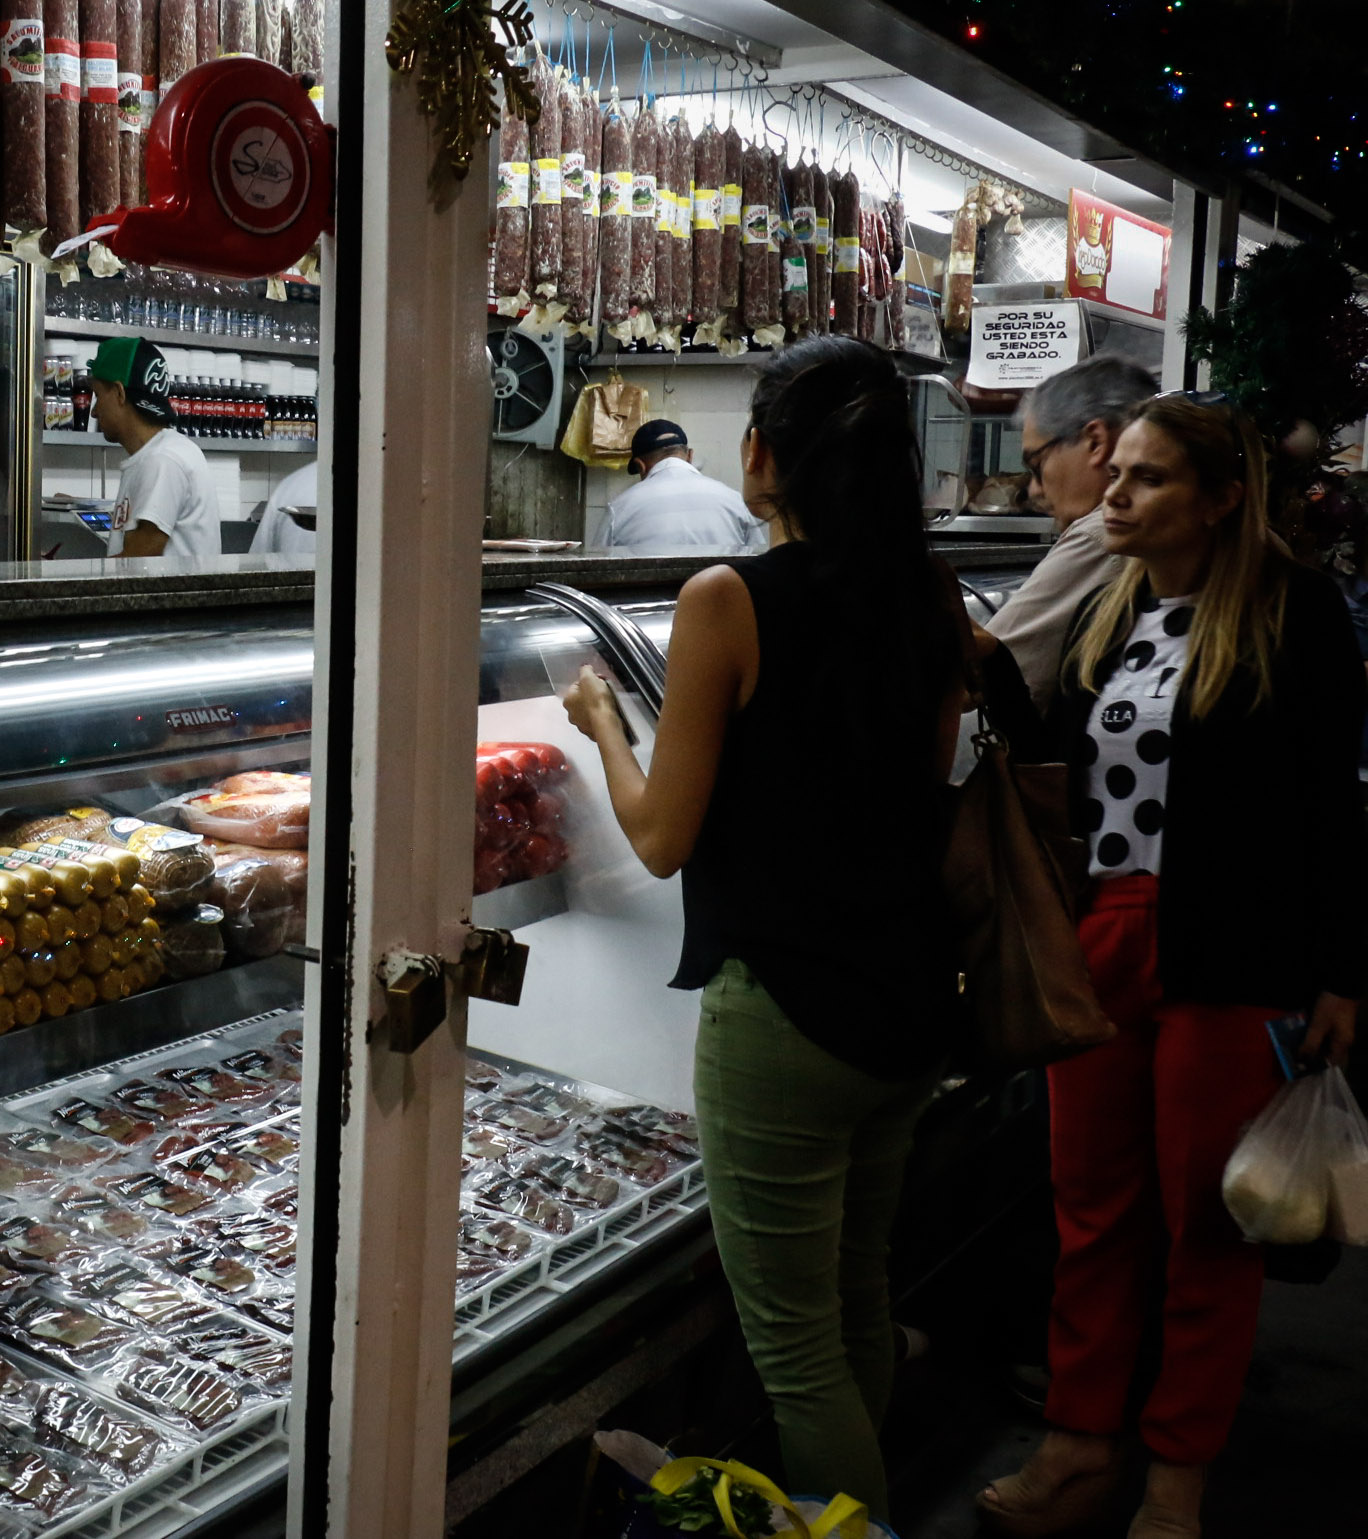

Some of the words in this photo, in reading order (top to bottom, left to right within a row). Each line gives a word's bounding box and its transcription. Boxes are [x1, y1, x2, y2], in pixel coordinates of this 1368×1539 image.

[998, 312, 1028, 321] POR
[1033, 311, 1053, 320] SU
[985, 321, 1066, 331] SEGURIDAD
[982, 332, 1027, 341] USTED
[1031, 331, 1068, 339] ESTA
[999, 341, 1050, 350] SIENDO
[986, 351, 1062, 360] GRABADO.
[169, 708, 231, 728] FRIMAC
